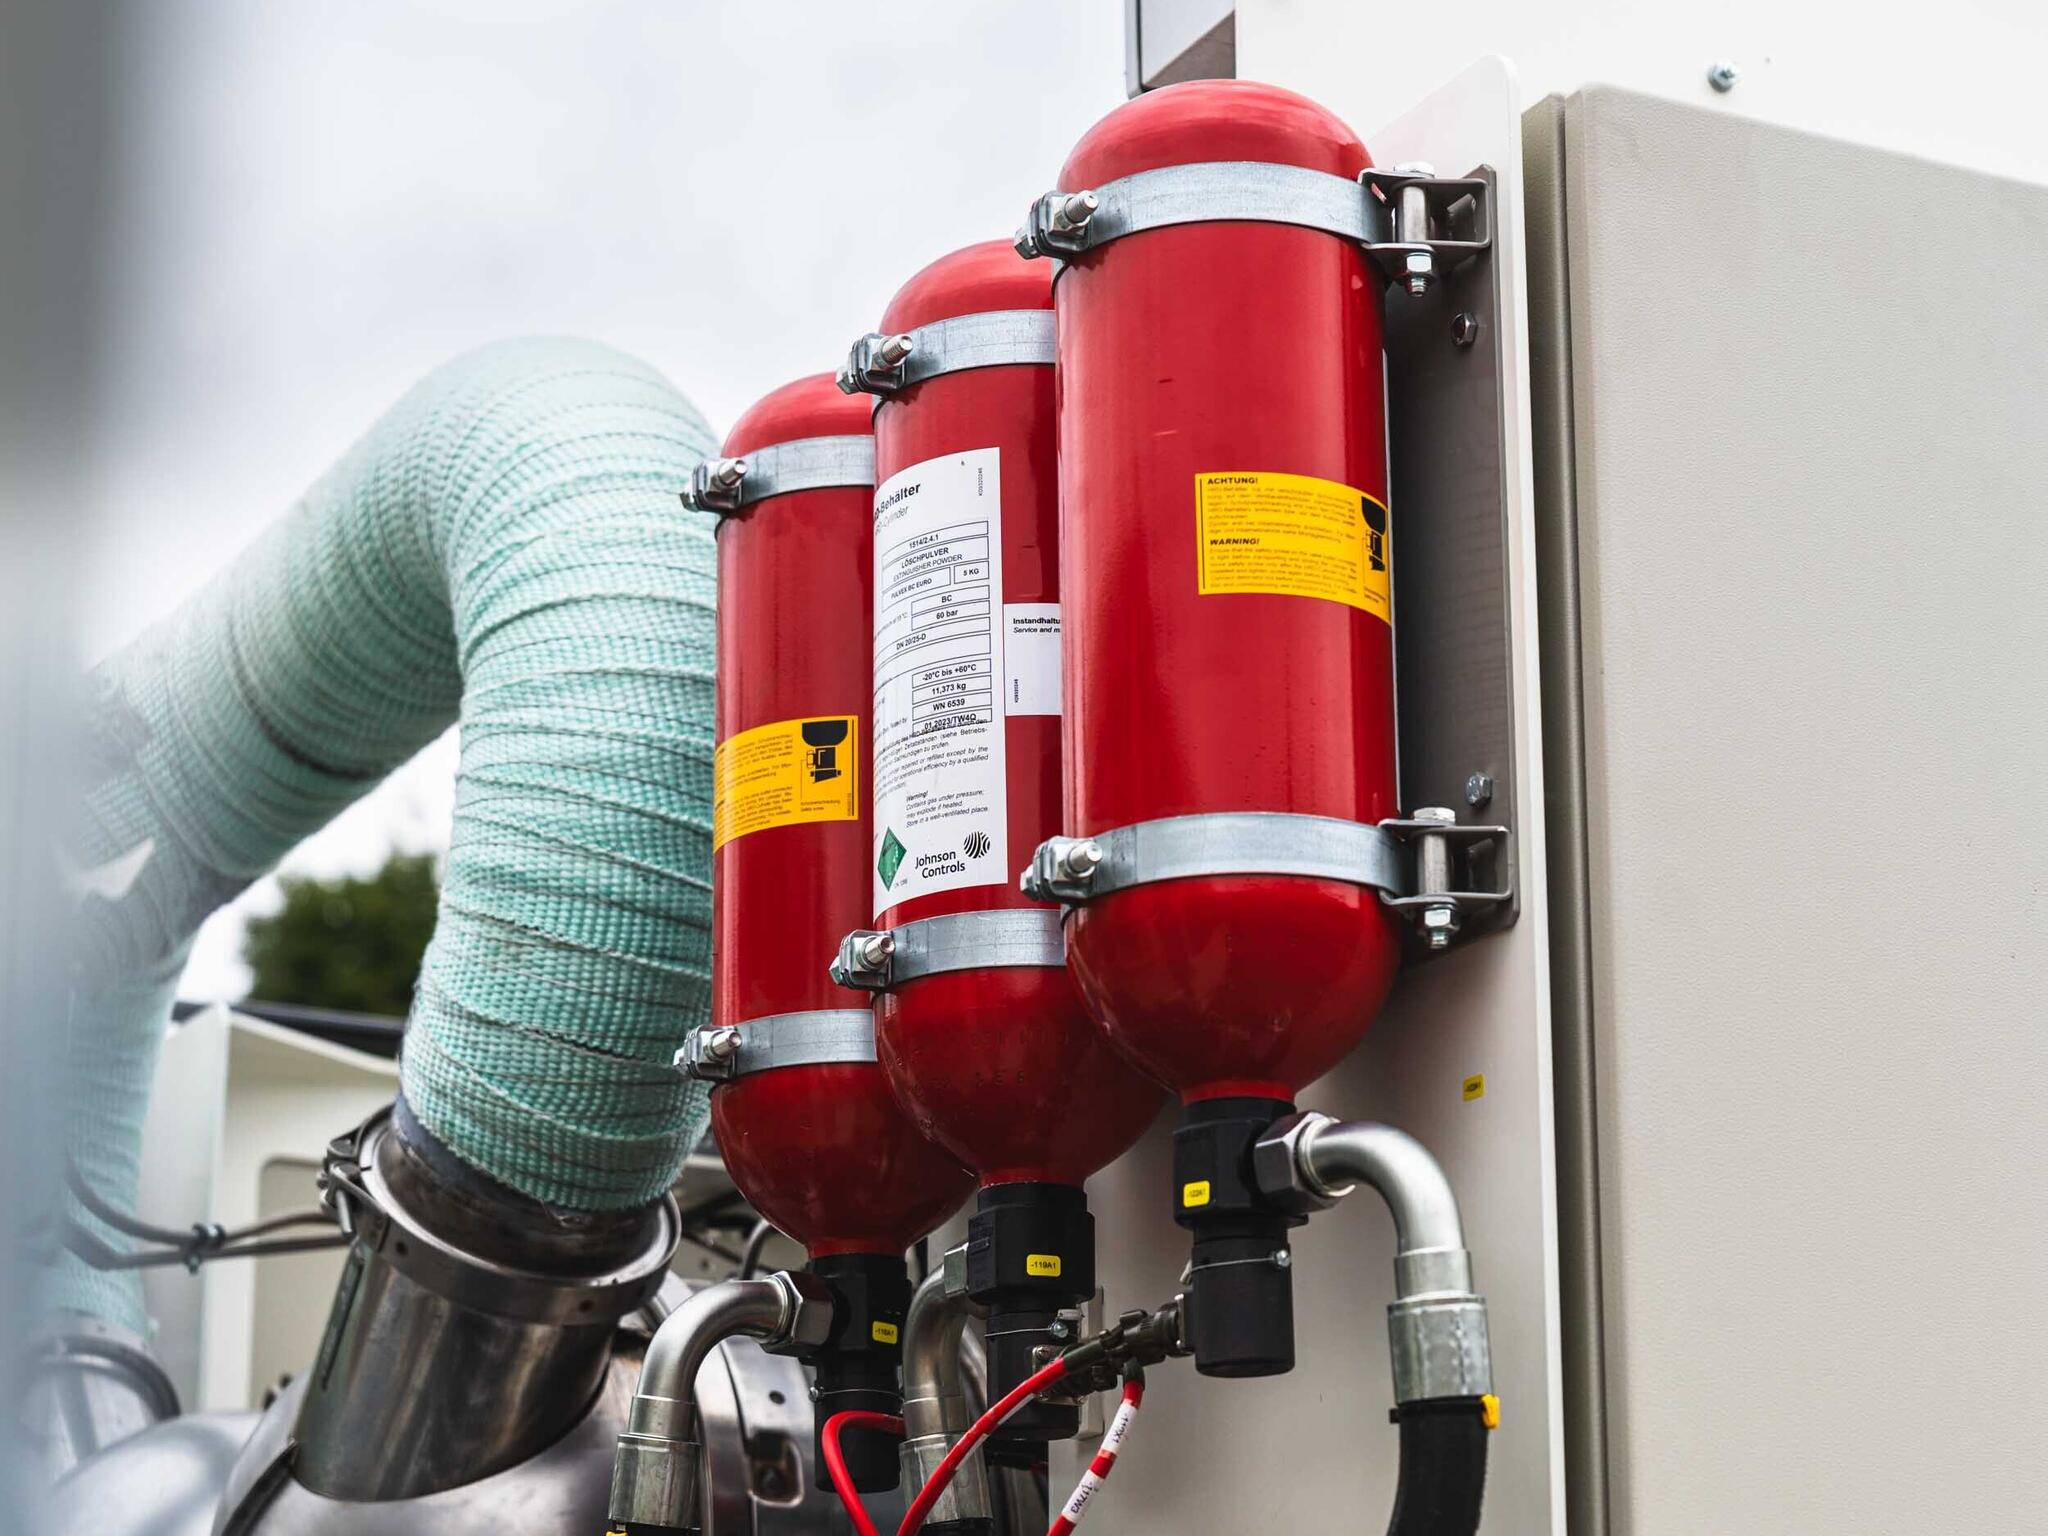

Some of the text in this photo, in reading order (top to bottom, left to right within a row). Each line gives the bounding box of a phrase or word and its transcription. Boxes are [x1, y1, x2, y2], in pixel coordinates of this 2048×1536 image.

[1207, 477, 1258, 485] ACHTUNG!
[909, 534, 939, 549] 1514/2.4.1
[901, 546, 949, 569] LÖSCHPULVER
[932, 554, 962, 566] POWDER
[916, 578, 932, 588] EURO
[941, 594, 952, 603] BC
[936, 609, 958, 620] 60 bar
[1013, 626, 1038, 634] Service
[922, 663, 977, 681] -20°C bis +60°C
[932, 682, 967, 695] 11,373 kg
[932, 698, 966, 711] WN 6539
[946, 749, 966, 758] except
[968, 747, 976, 755] by
[915, 850, 956, 870] Johnson
[921, 860, 966, 879] Controls
